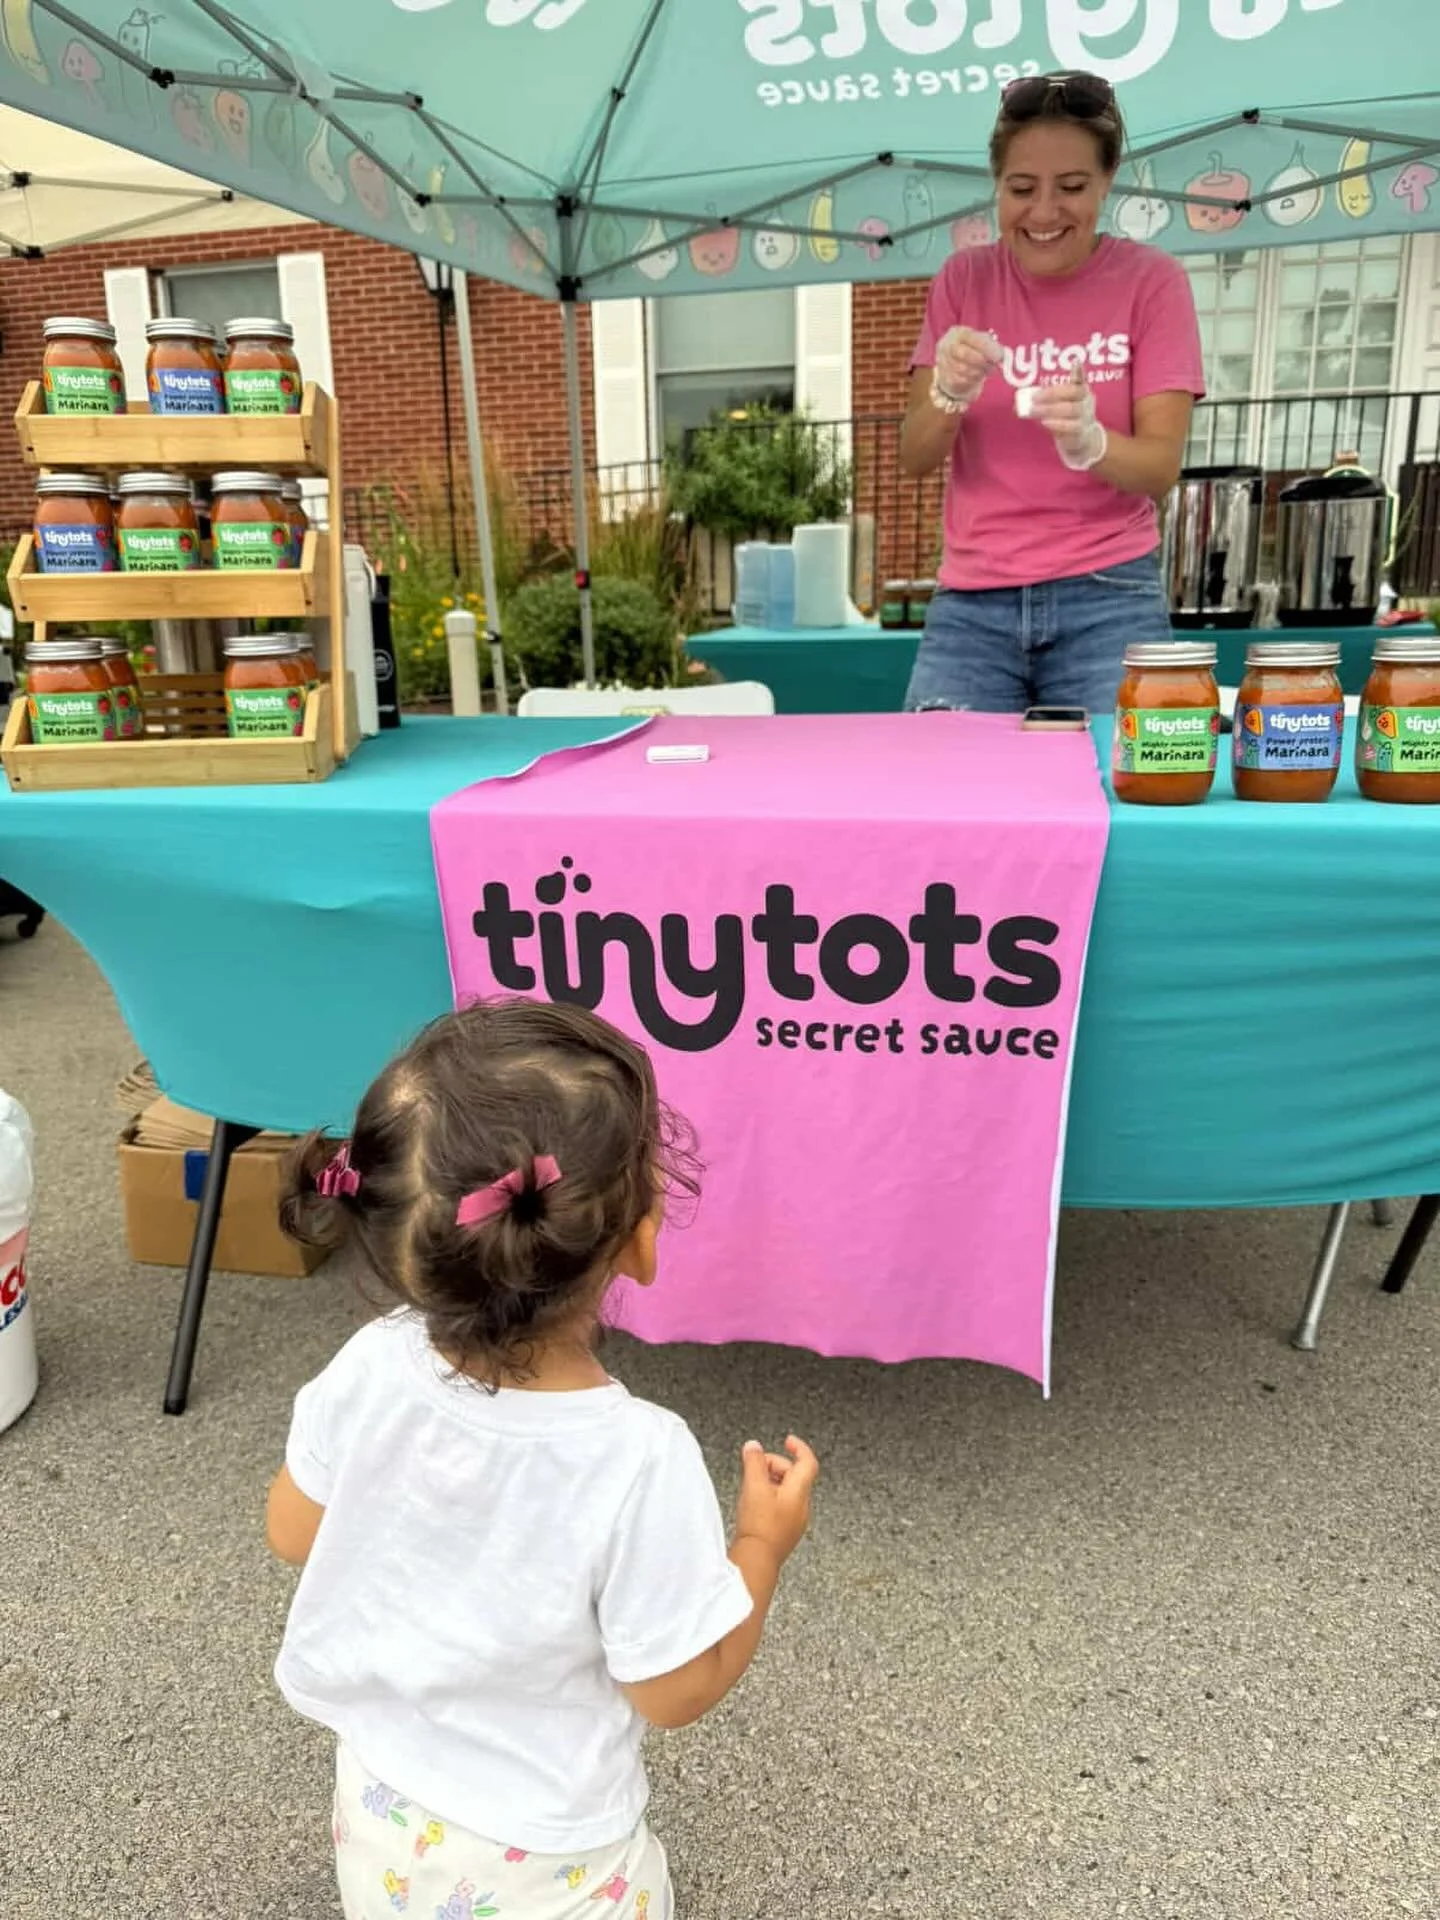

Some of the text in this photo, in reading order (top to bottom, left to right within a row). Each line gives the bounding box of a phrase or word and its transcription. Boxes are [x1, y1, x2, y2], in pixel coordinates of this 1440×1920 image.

[58, 401, 109, 411] Marinara
[165, 400, 214, 411] Marinara
[45, 530, 93, 546] tinytots
[47, 556, 97, 567] Marinara
[42, 700, 93, 716] tinytots
[237, 722, 287, 731] Marinara
[1144, 716, 1205, 736] tinytots
[1270, 713, 1330, 733] tinytots
[1406, 716, 1440, 734] tiny
[43, 726, 98, 736] Marinara
[1141, 750, 1204, 761] Marinara
[1265, 746, 1329, 758] Marinara
[472, 856, 1061, 1052] tinytots
[755, 1016, 1059, 1060] secret sauce
